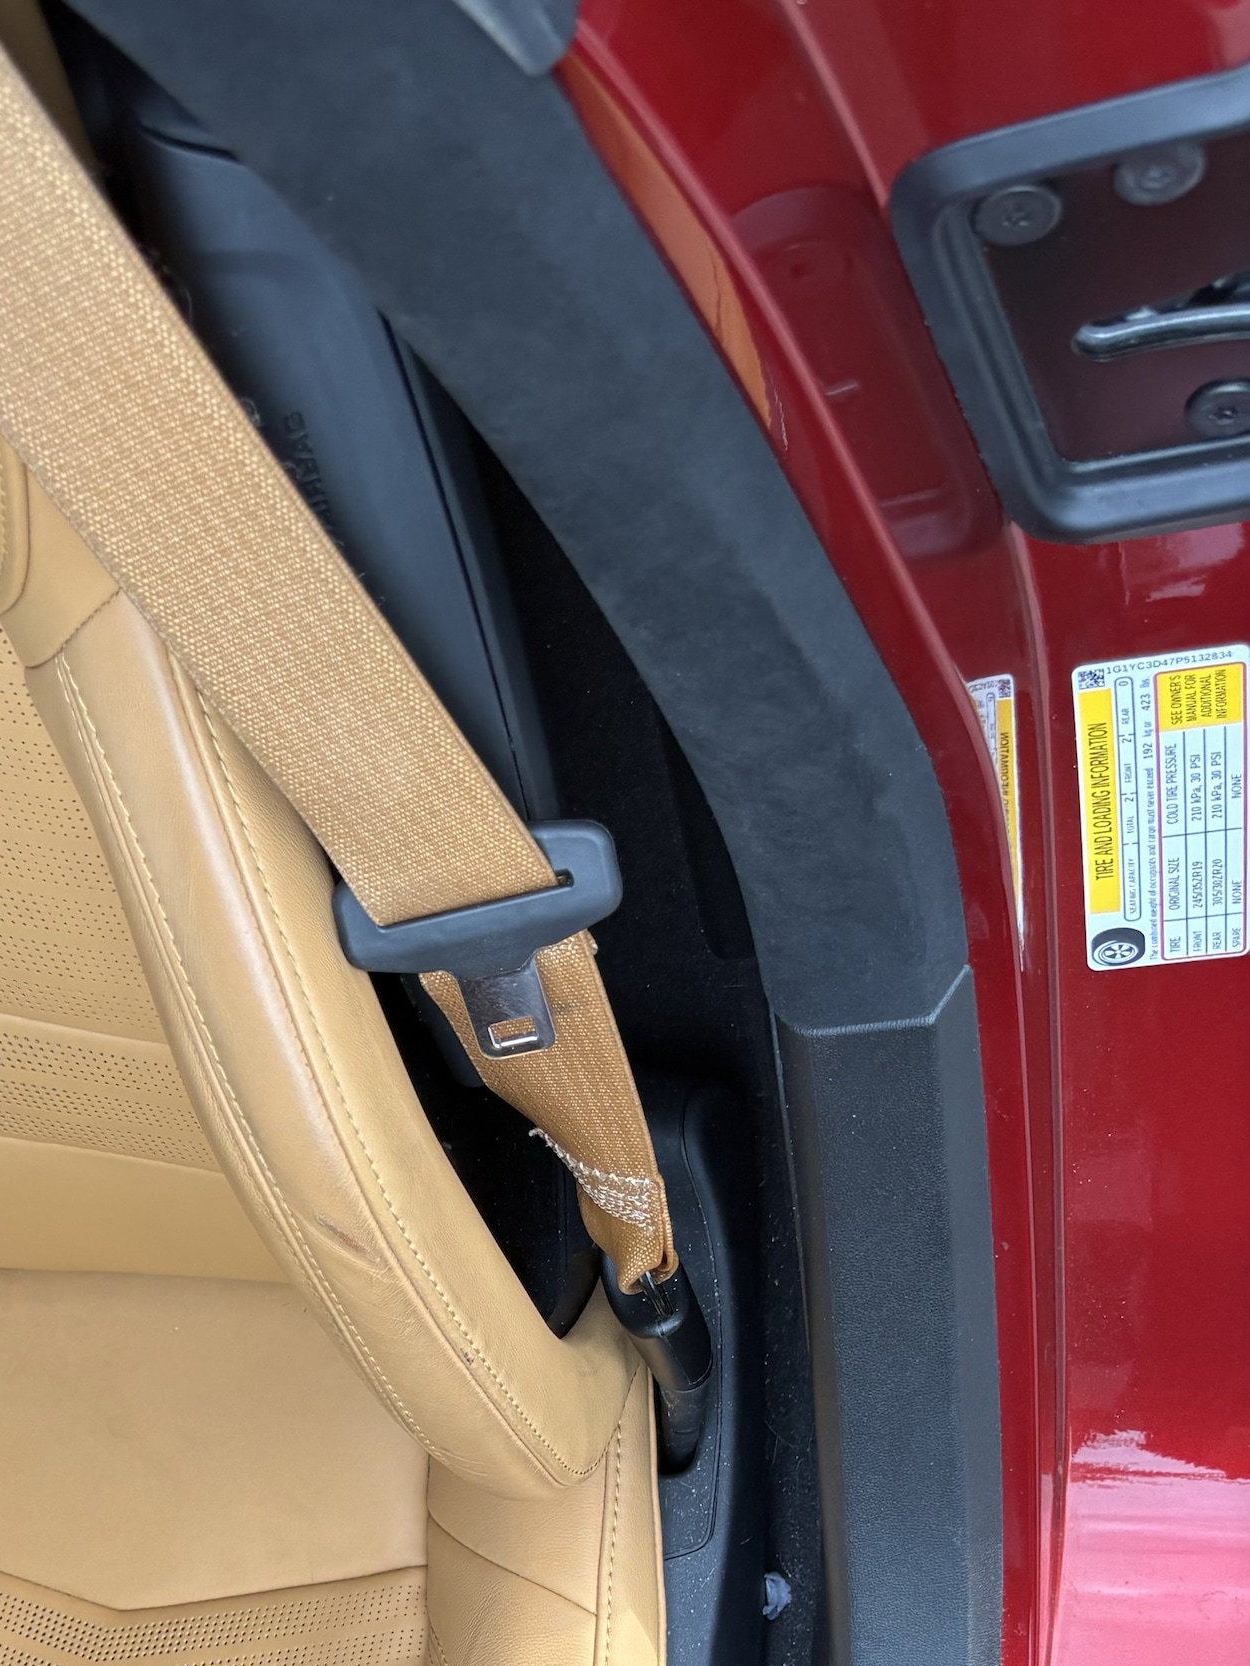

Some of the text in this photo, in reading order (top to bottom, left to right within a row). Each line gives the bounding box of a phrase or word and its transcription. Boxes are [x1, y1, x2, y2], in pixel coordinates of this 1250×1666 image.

[1106, 650, 1233, 674] 1G1YC3D47P5132834
[1140, 694, 1150, 710] 423
[1169, 675, 1182, 725] SEE OWNER'S
[1185, 674, 1196, 721] MANUAL FOR
[1200, 674, 1211, 717] ADDITIONAL
[1215, 669, 1227, 719] INFORMATION
[1122, 708, 1130, 724] REAR
[1142, 729, 1153, 737] kg
[1143, 743, 1153, 759] 192
[1124, 763, 1132, 783] FRONT
[1144, 768, 1154, 789] exceed
[1165, 744, 1178, 824] COLD TIRE PRESSURE
[1190, 754, 1202, 821] 210 kPa, 30 PSI
[1211, 751, 1222, 818] 210 kPa, 30 PSI
[1231, 774, 1242, 799] NONE
[1087, 722, 1114, 880] TIRE AND LOADING INFORMATION
[1126, 816, 1134, 834] TOTAL
[1148, 845, 1156, 855] and
[1148, 858, 1158, 889] occupants
[1168, 858, 1180, 952] TIRE ORIGINAL SIZE
[1192, 861, 1203, 951] FRONT 245/35ZR19
[1212, 859, 1222, 949] REAR 305/30ZR20
[1232, 880, 1242, 947] SPARE NONE
